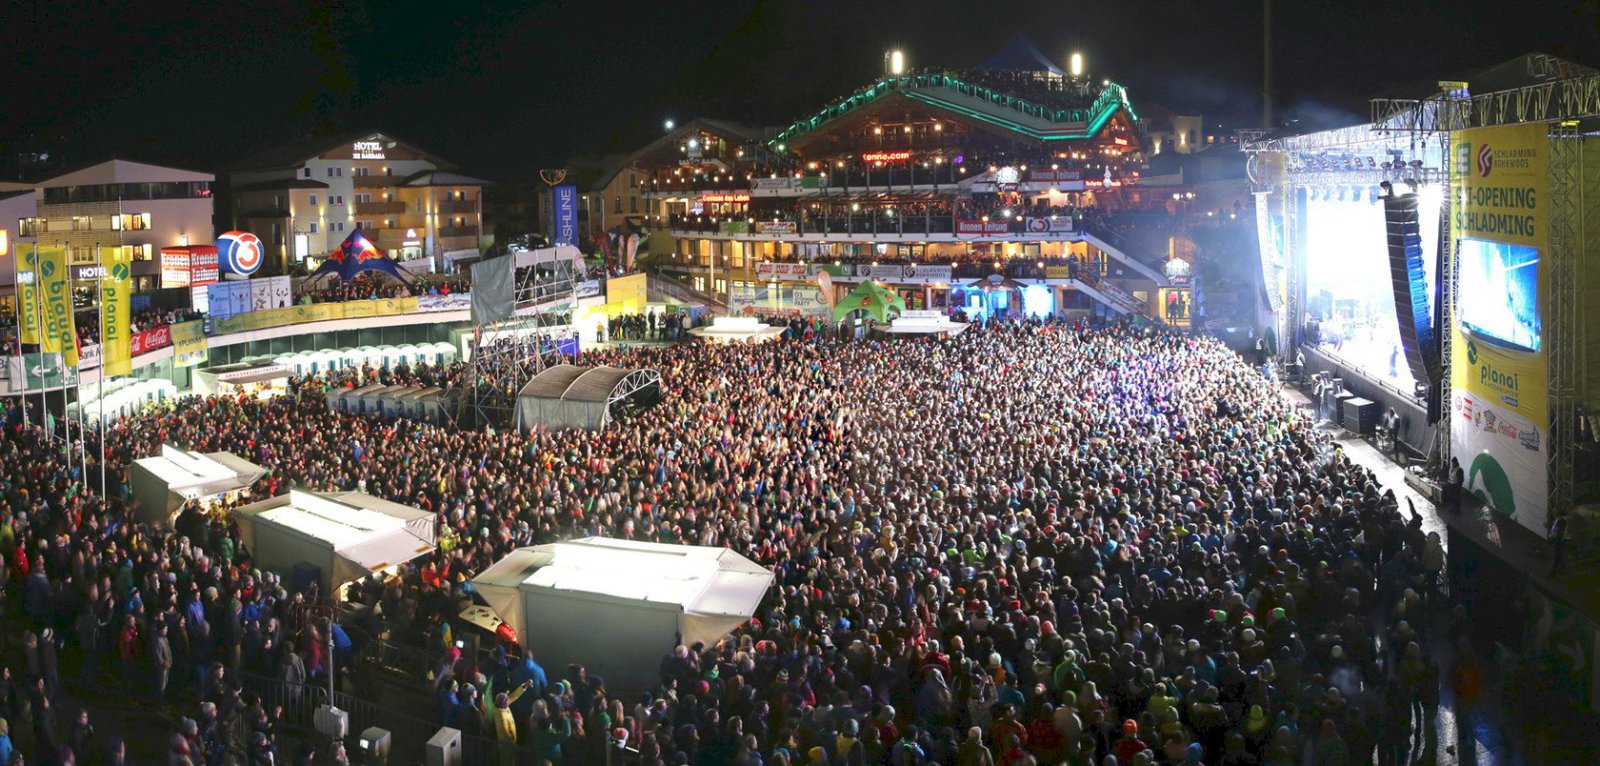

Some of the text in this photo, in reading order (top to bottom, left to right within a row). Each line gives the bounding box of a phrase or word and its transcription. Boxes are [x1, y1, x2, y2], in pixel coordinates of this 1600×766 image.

[354, 141, 382, 151] HOTEL
[862, 152, 910, 161] tenne.com
[1031, 168, 1080, 180] Kronen Zeitung
[959, 221, 1008, 233] Kronen Zeitung
[1456, 211, 1535, 237] SCHLADMING
[191, 253, 219, 267] Kronen
[79, 267, 109, 279] HOTEL
[103, 286, 119, 341] planai
[144, 328, 169, 348] Coca-Cola
[1481, 364, 1518, 391] planai
